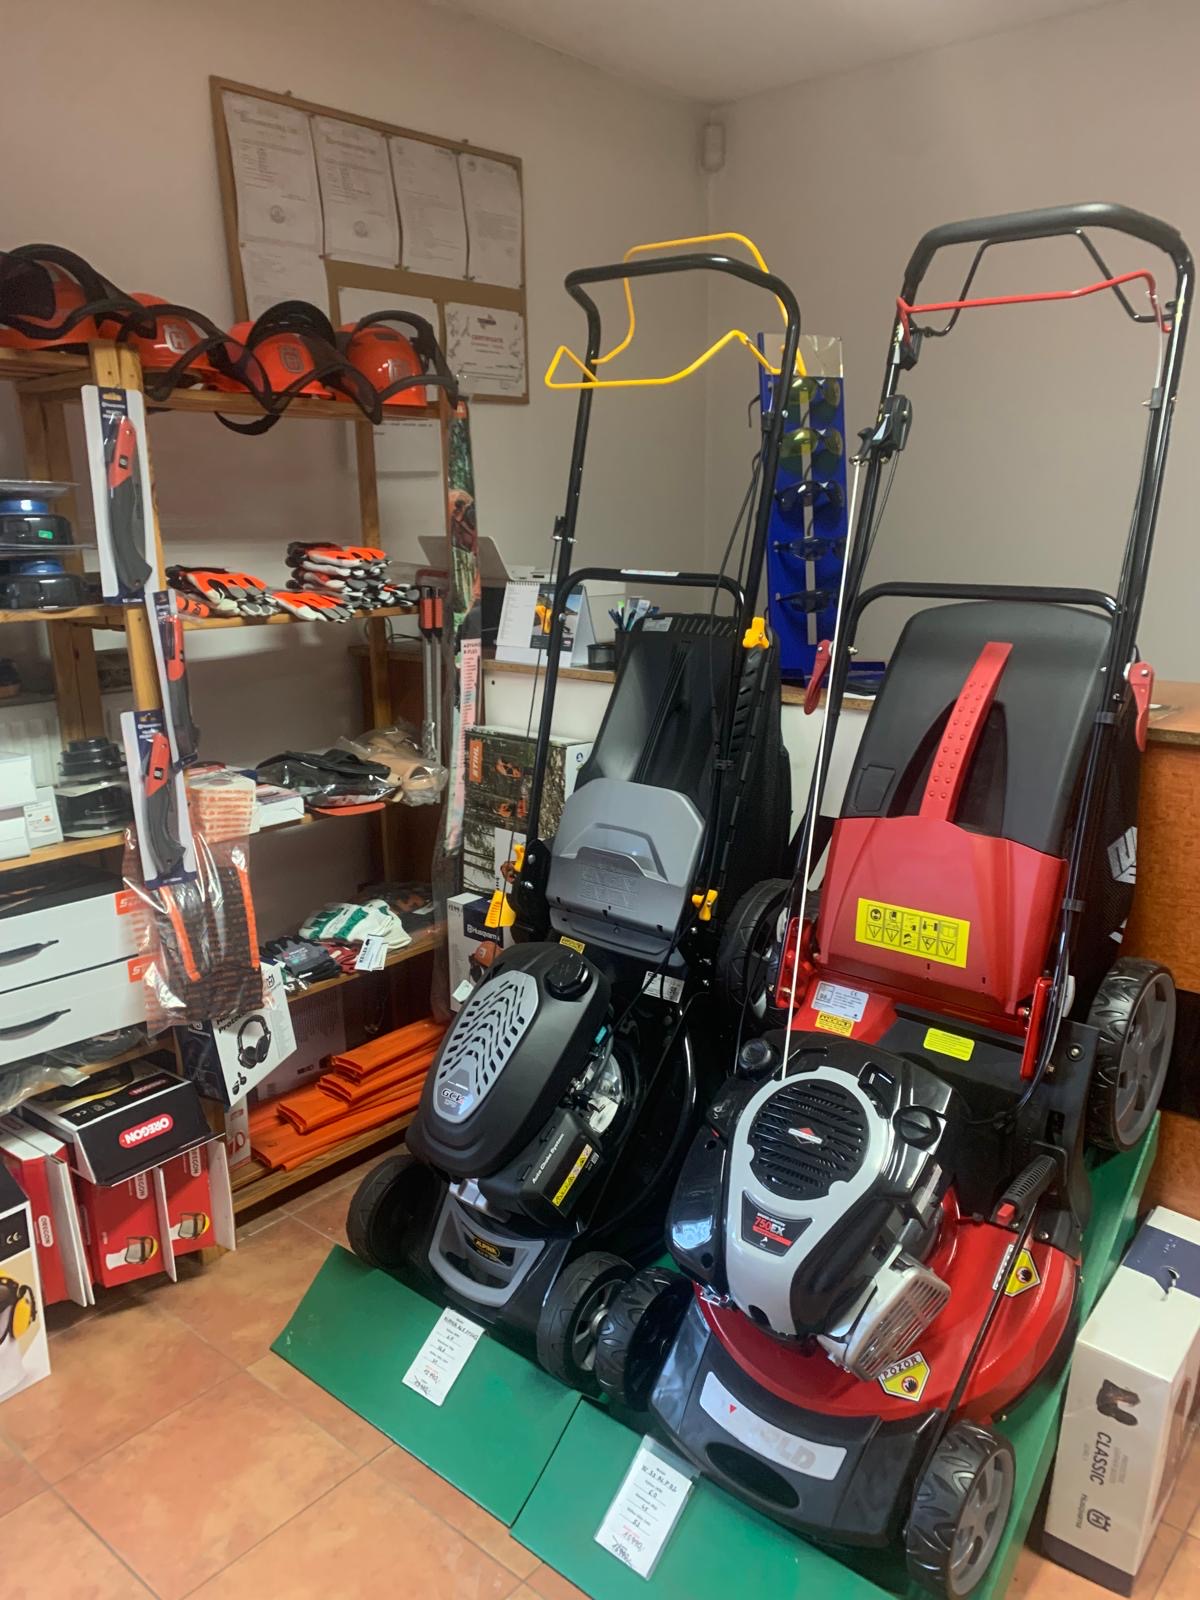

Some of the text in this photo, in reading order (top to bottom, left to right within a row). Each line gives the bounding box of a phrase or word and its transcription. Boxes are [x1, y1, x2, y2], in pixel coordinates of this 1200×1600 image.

[471, 745, 481, 779] STIHL
[125, 1117, 170, 1144] OREGON
[550, 1133, 565, 1153] System
[40, 1217, 51, 1245] OREGON
[754, 1216, 785, 1236] 750EX
[883, 1356, 920, 1379] POZOR
[1089, 1431, 1112, 1486] CLASSIC
